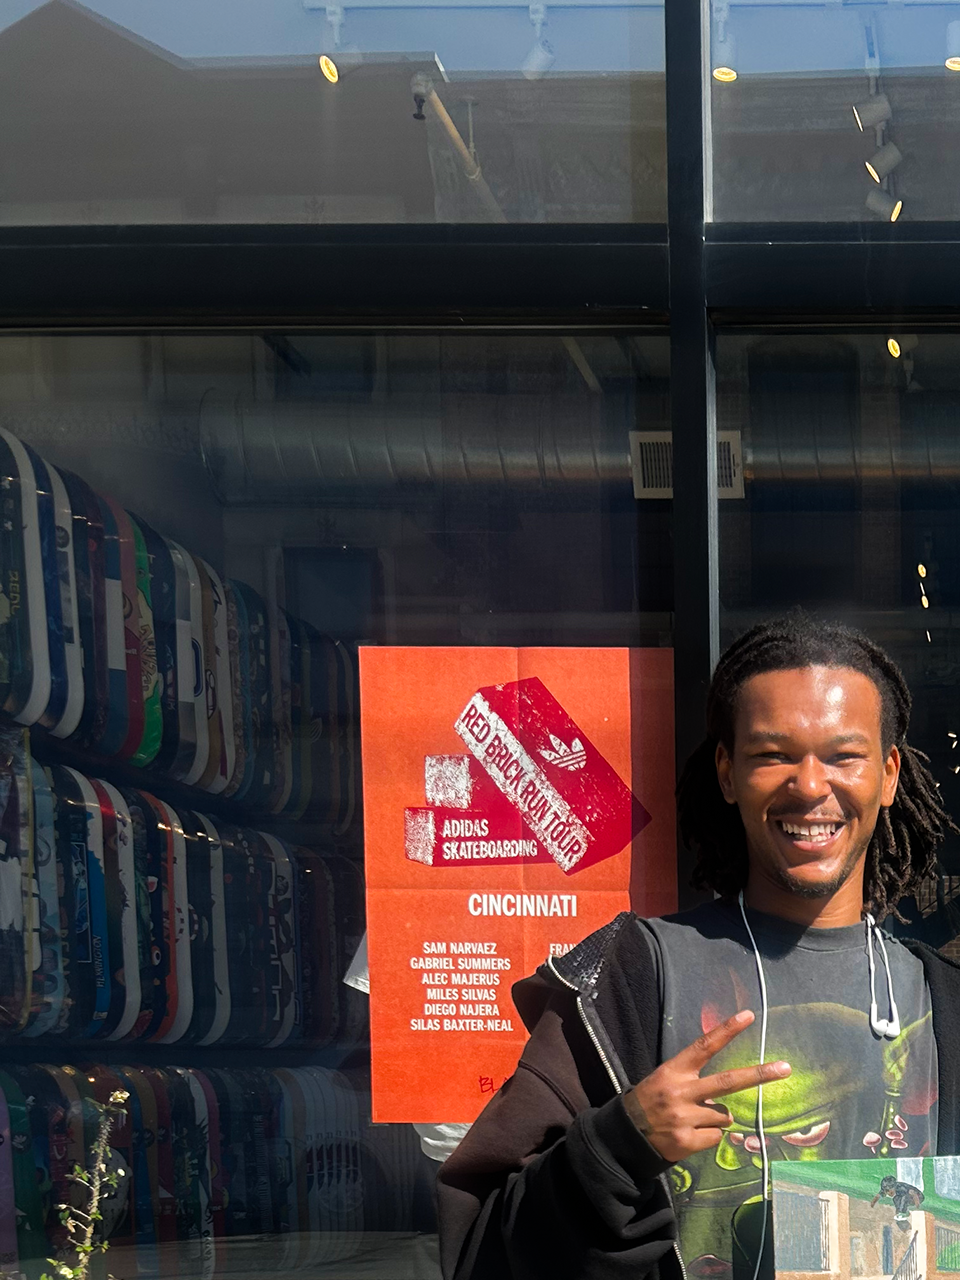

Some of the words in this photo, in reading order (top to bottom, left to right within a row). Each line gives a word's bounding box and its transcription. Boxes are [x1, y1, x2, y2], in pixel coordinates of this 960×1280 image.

[461, 703, 491, 745] RED
[484, 735, 528, 792] BRICK
[520, 782, 553, 824] RUN
[543, 811, 584, 864] TOUR
[442, 819, 489, 838] ADIDAS
[442, 840, 538, 860] SKATEBOARDING
[468, 893, 577, 917] CINCINNATI
[423, 942, 447, 955] SAM
[450, 942, 497, 955] NARVAEZ
[410, 957, 455, 970] GABRIEL
[458, 958, 511, 970] SUMMERS
[422, 973, 448, 985] ALEC
[451, 973, 500, 986] MAJERUS
[427, 988, 459, 1001] MILES
[461, 989, 496, 1001] SILVAS
[424, 1004, 456, 1016] DIEGO
[460, 1004, 500, 1016] NAJERA
[410, 1019, 440, 1031] SILAS
[443, 1019, 513, 1032] BAXTER-NEAL
